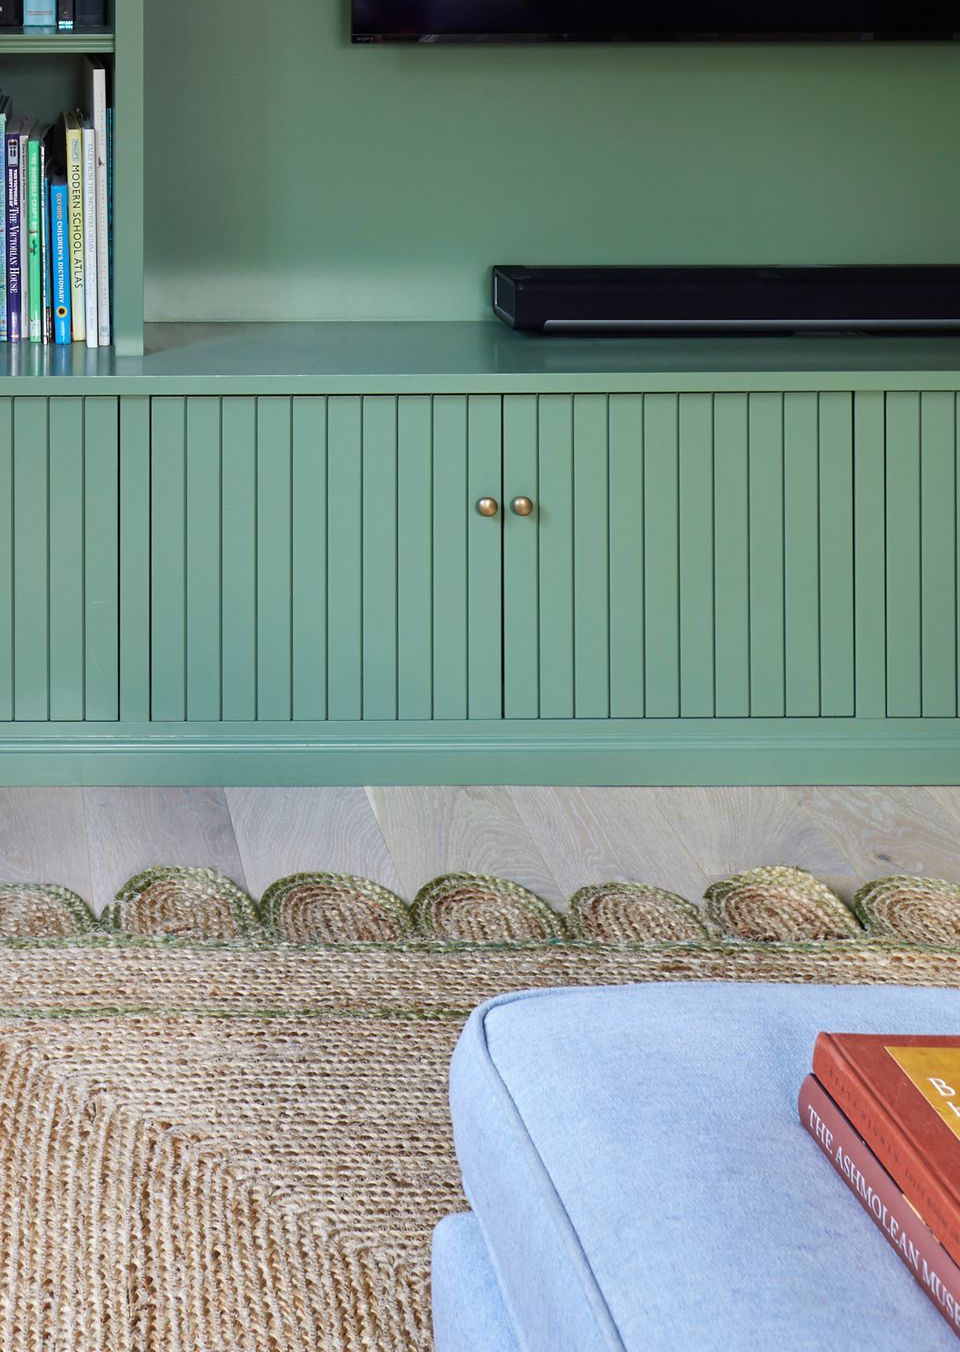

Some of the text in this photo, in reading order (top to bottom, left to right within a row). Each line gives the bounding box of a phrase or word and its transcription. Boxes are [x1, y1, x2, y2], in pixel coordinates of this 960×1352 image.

[9, 225, 20, 294] VICTORIAN HOUSE
[57, 220, 67, 304] CHILDREN'S DICTIONARY
[72, 164, 84, 289] MODERN SCHOOL ATLAS
[808, 1104, 833, 1155] THE
[835, 1145, 920, 1270] ASHMOLEAN
